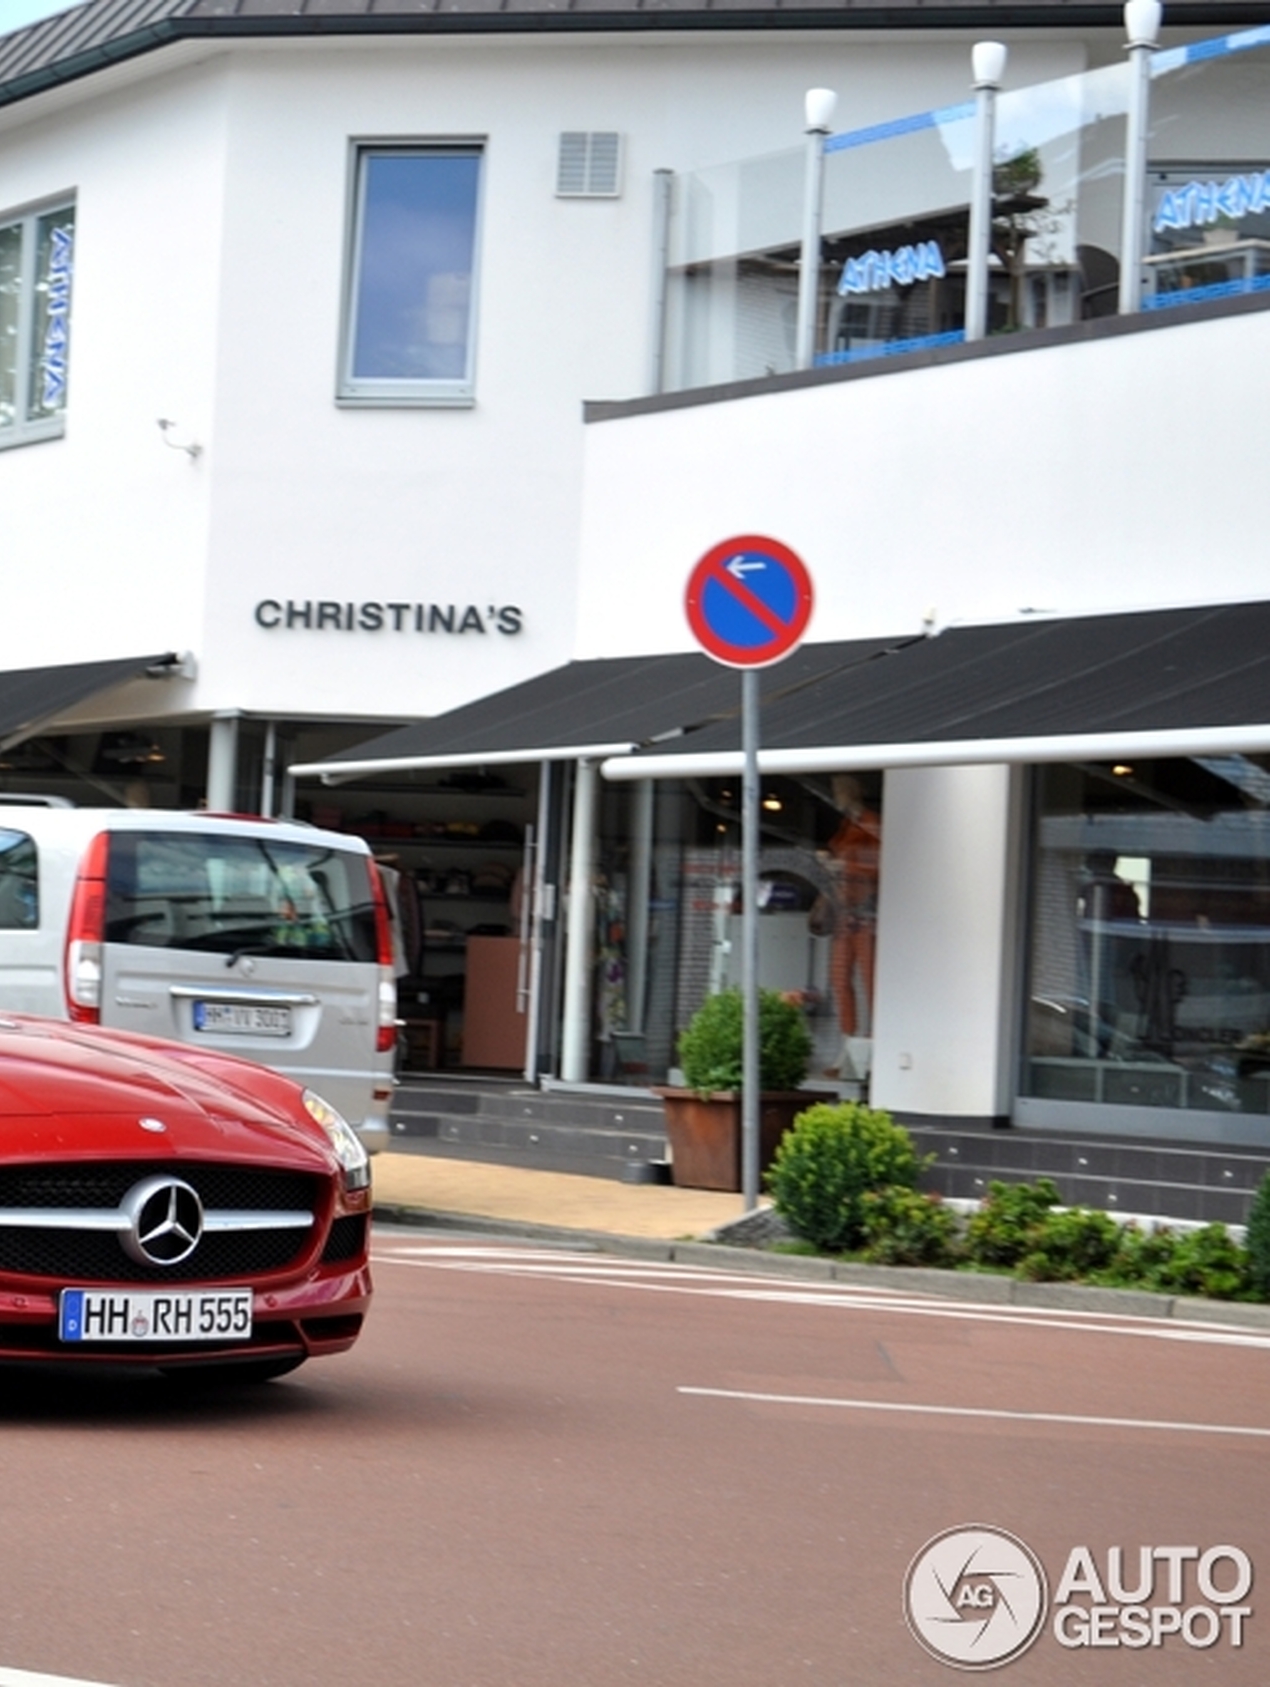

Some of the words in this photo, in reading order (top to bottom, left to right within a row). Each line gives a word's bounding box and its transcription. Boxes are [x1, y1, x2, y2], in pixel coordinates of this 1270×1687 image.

[839, 241, 945, 295] ATHENA
[255, 599, 522, 635] CHRISTINA'S
[84, 1297, 129, 1335] HH
[153, 1298, 192, 1334] RH
[199, 1297, 249, 1333] 555
